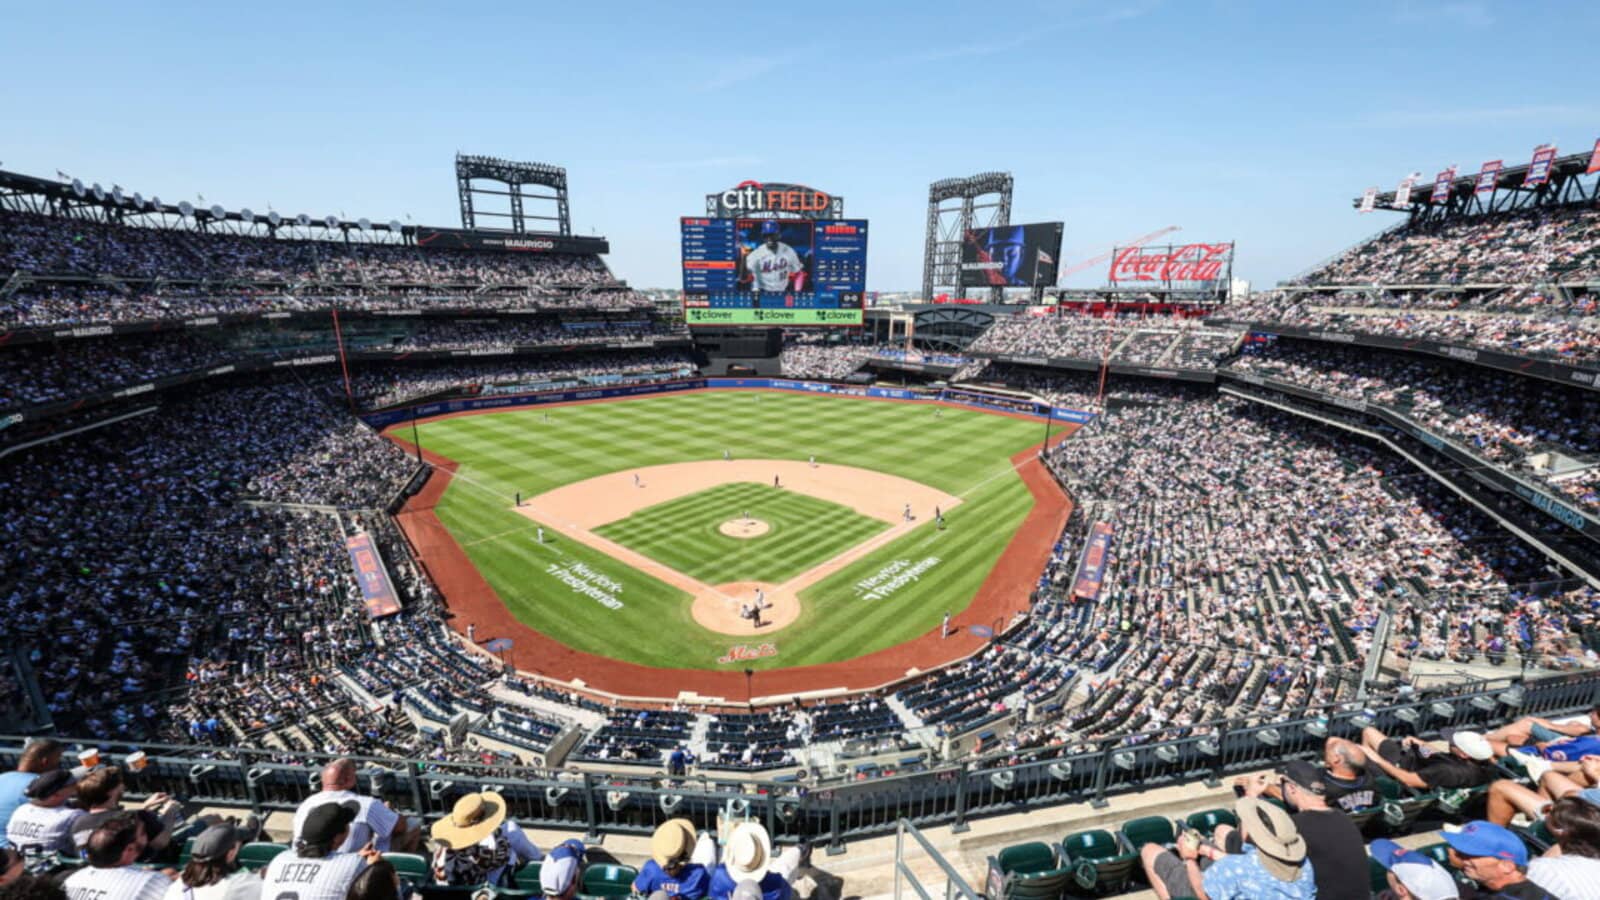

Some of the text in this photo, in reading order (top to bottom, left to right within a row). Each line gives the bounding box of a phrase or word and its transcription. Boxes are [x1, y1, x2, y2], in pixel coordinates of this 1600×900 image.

[722, 184, 829, 211] citi FIELD
[505, 239, 554, 249] MAURICIO
[1109, 243, 1232, 281] Coca-Cola
[702, 310, 732, 319] clover
[764, 310, 795, 319] clover
[827, 310, 856, 319] clover
[717, 643, 777, 664] Mets
[274, 863, 322, 885] JETER
